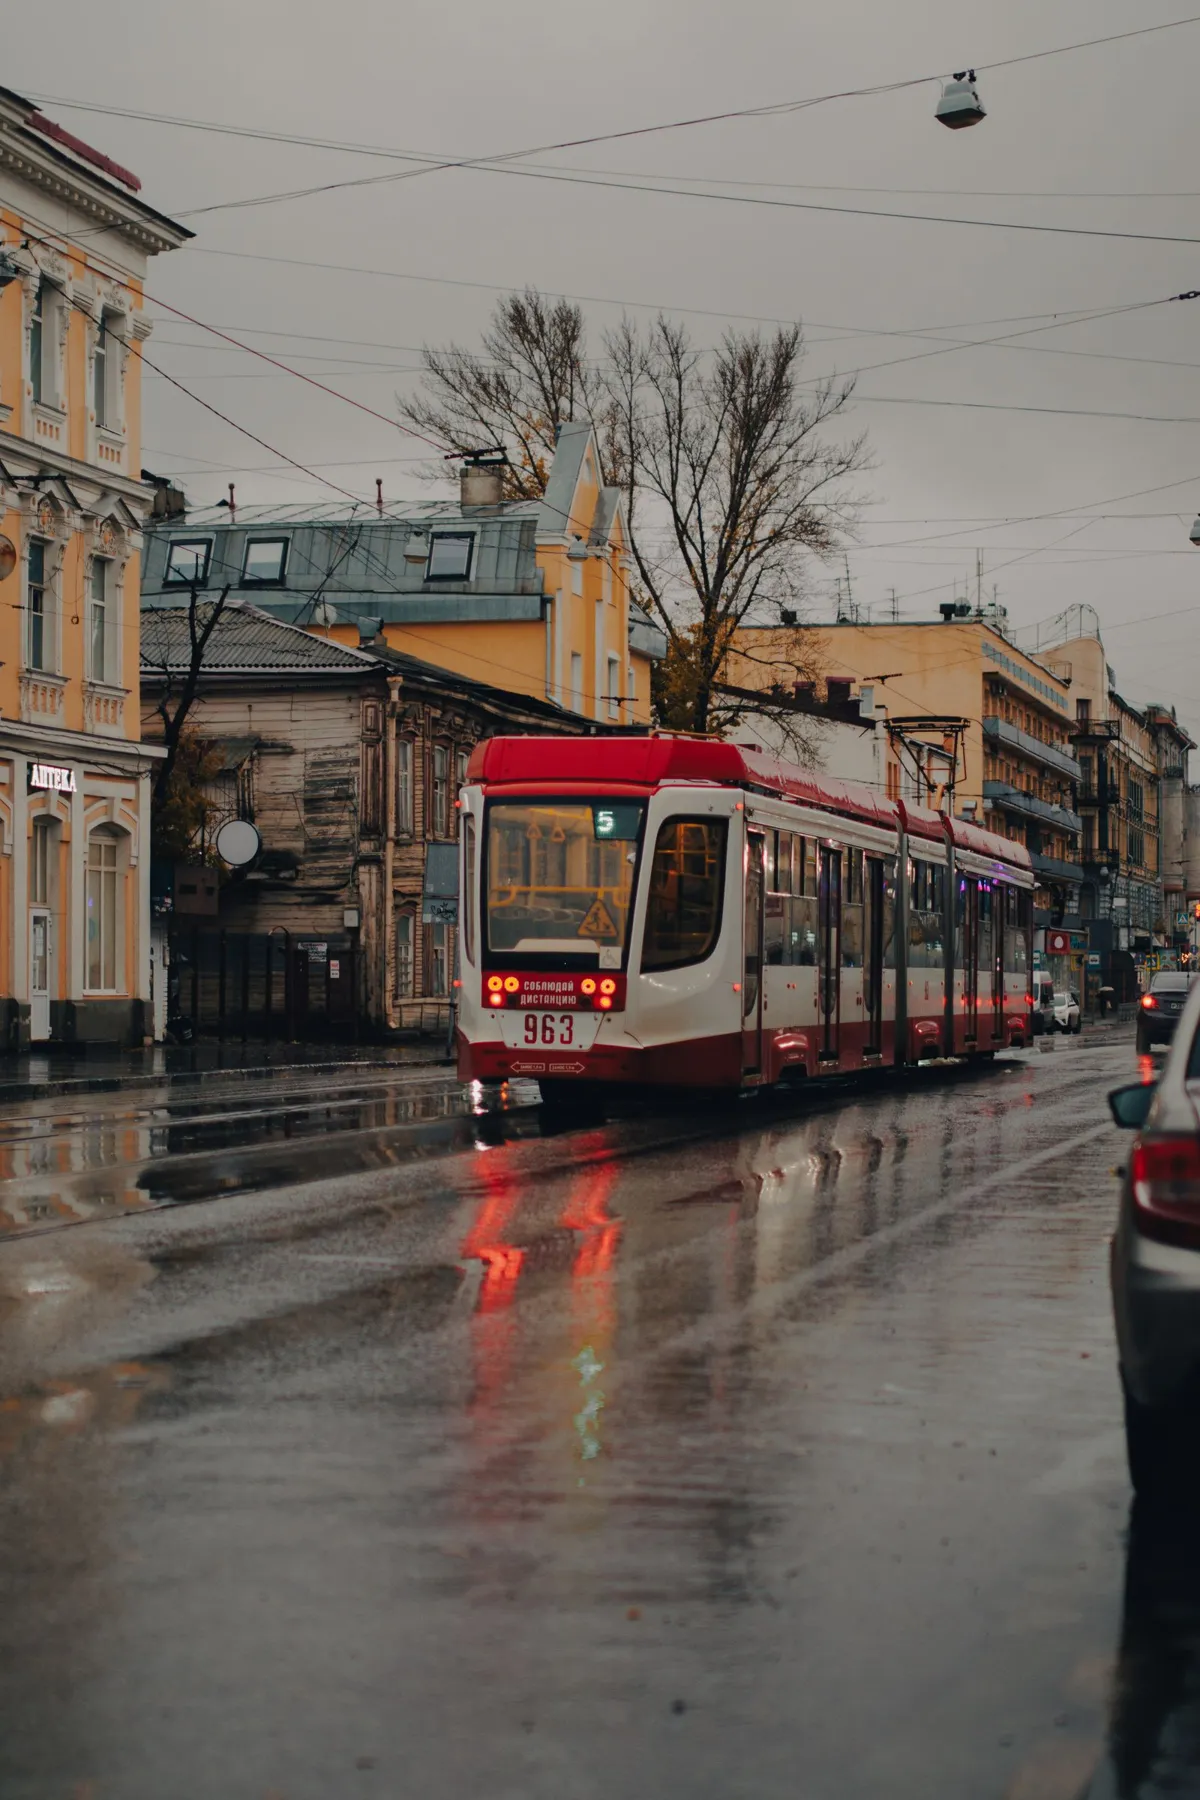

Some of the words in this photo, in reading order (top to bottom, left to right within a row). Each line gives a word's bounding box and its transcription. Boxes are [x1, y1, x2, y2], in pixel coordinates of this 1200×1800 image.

[31, 764, 77, 792] АПТЕКА
[598, 811, 613, 831] 5
[524, 981, 574, 993] СОБЛЮДАЙ
[520, 994, 577, 1006] ДИСТАНЦИЮ
[524, 1014, 574, 1044] 963
